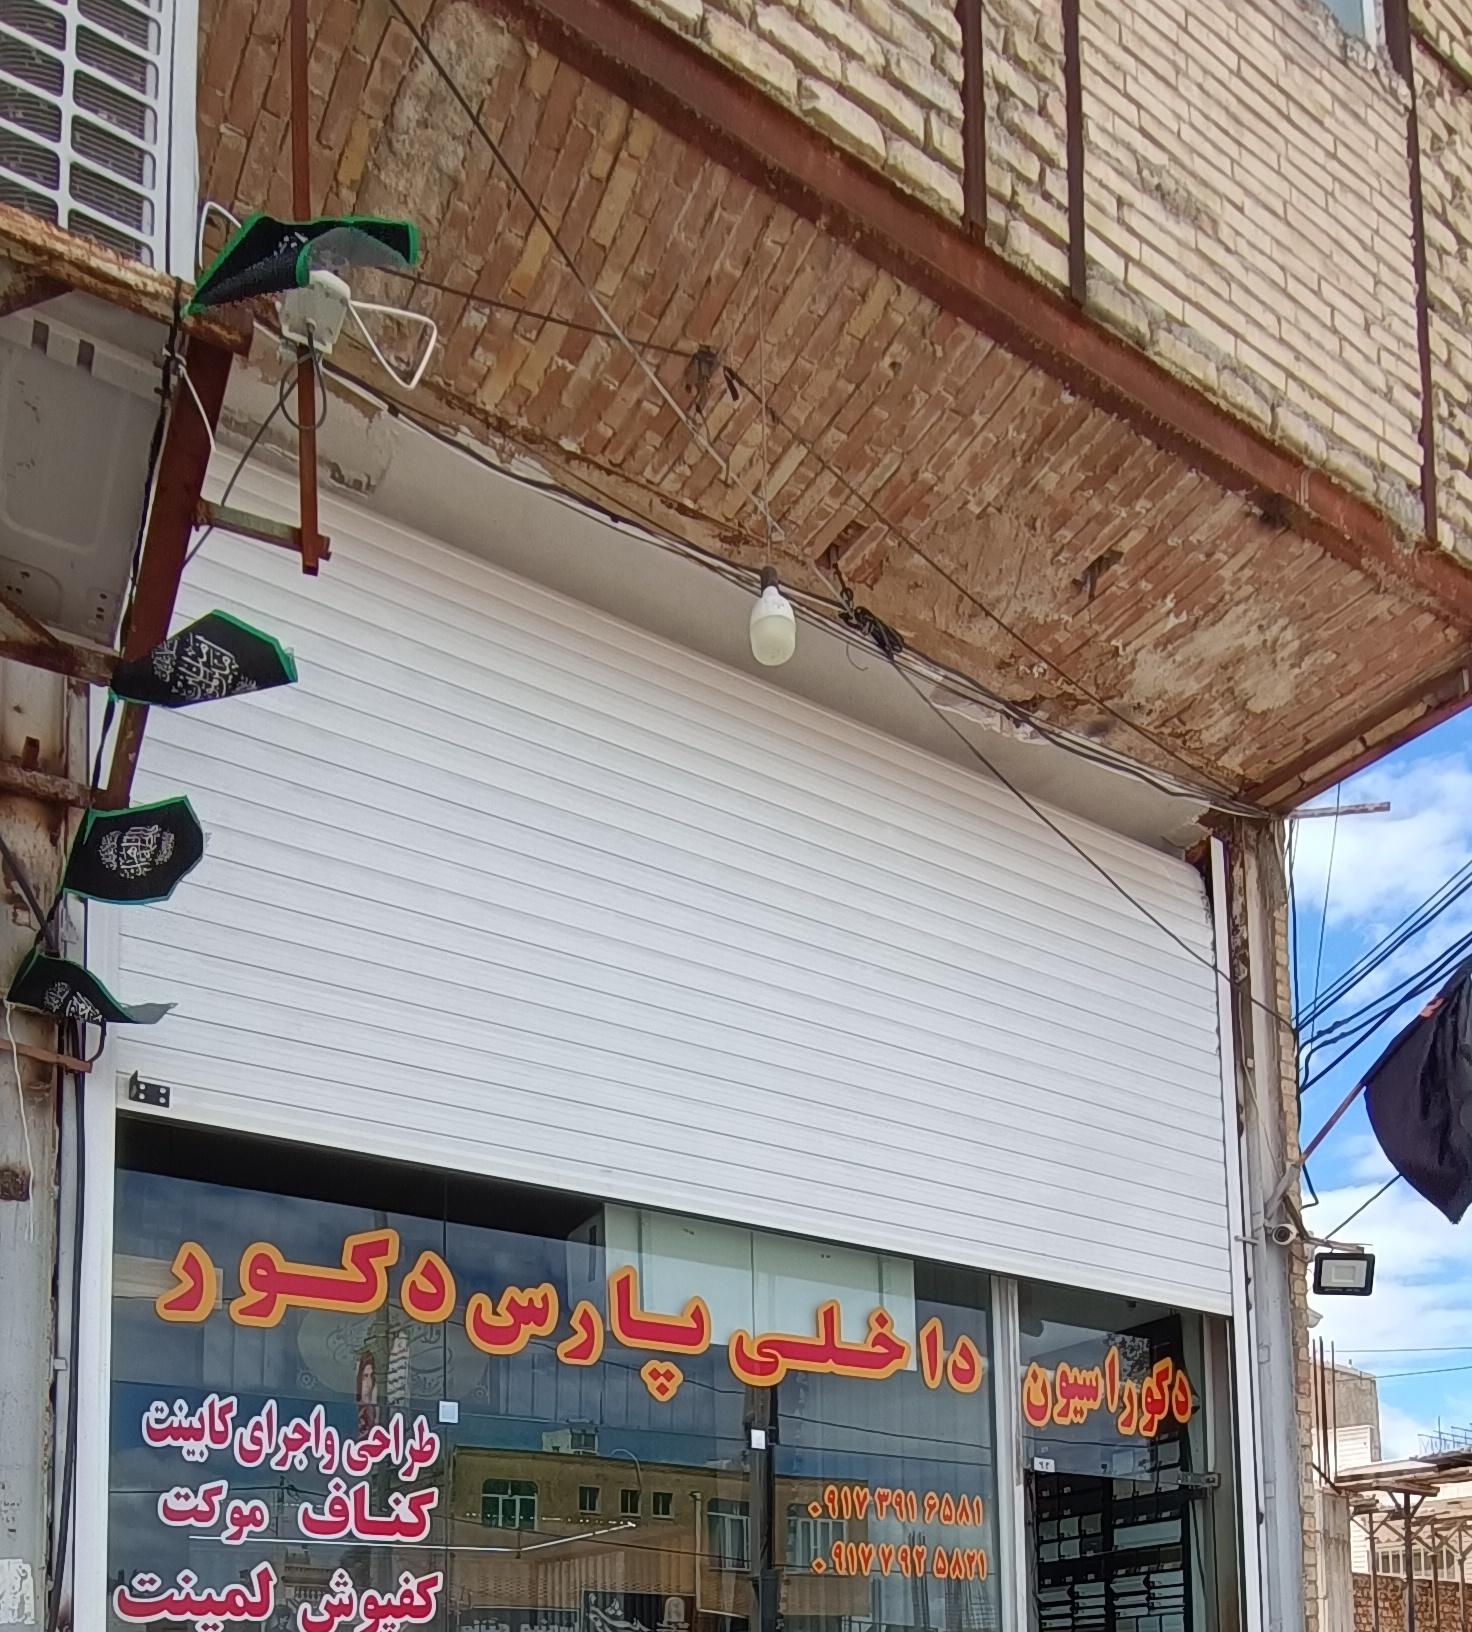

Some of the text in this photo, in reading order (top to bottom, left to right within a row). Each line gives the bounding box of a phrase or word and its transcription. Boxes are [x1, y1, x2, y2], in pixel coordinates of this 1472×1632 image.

[156, 1229, 456, 1327] دکور
[465, 1266, 711, 1402] پارس
[728, 1299, 982, 1393] داخلی
[142, 1393, 237, 1462] کابینت
[1022, 1346, 1193, 1437] دکوراسیون
[342, 1412, 440, 1481] طراحی
[158, 1477, 438, 1545] کناف موکت
